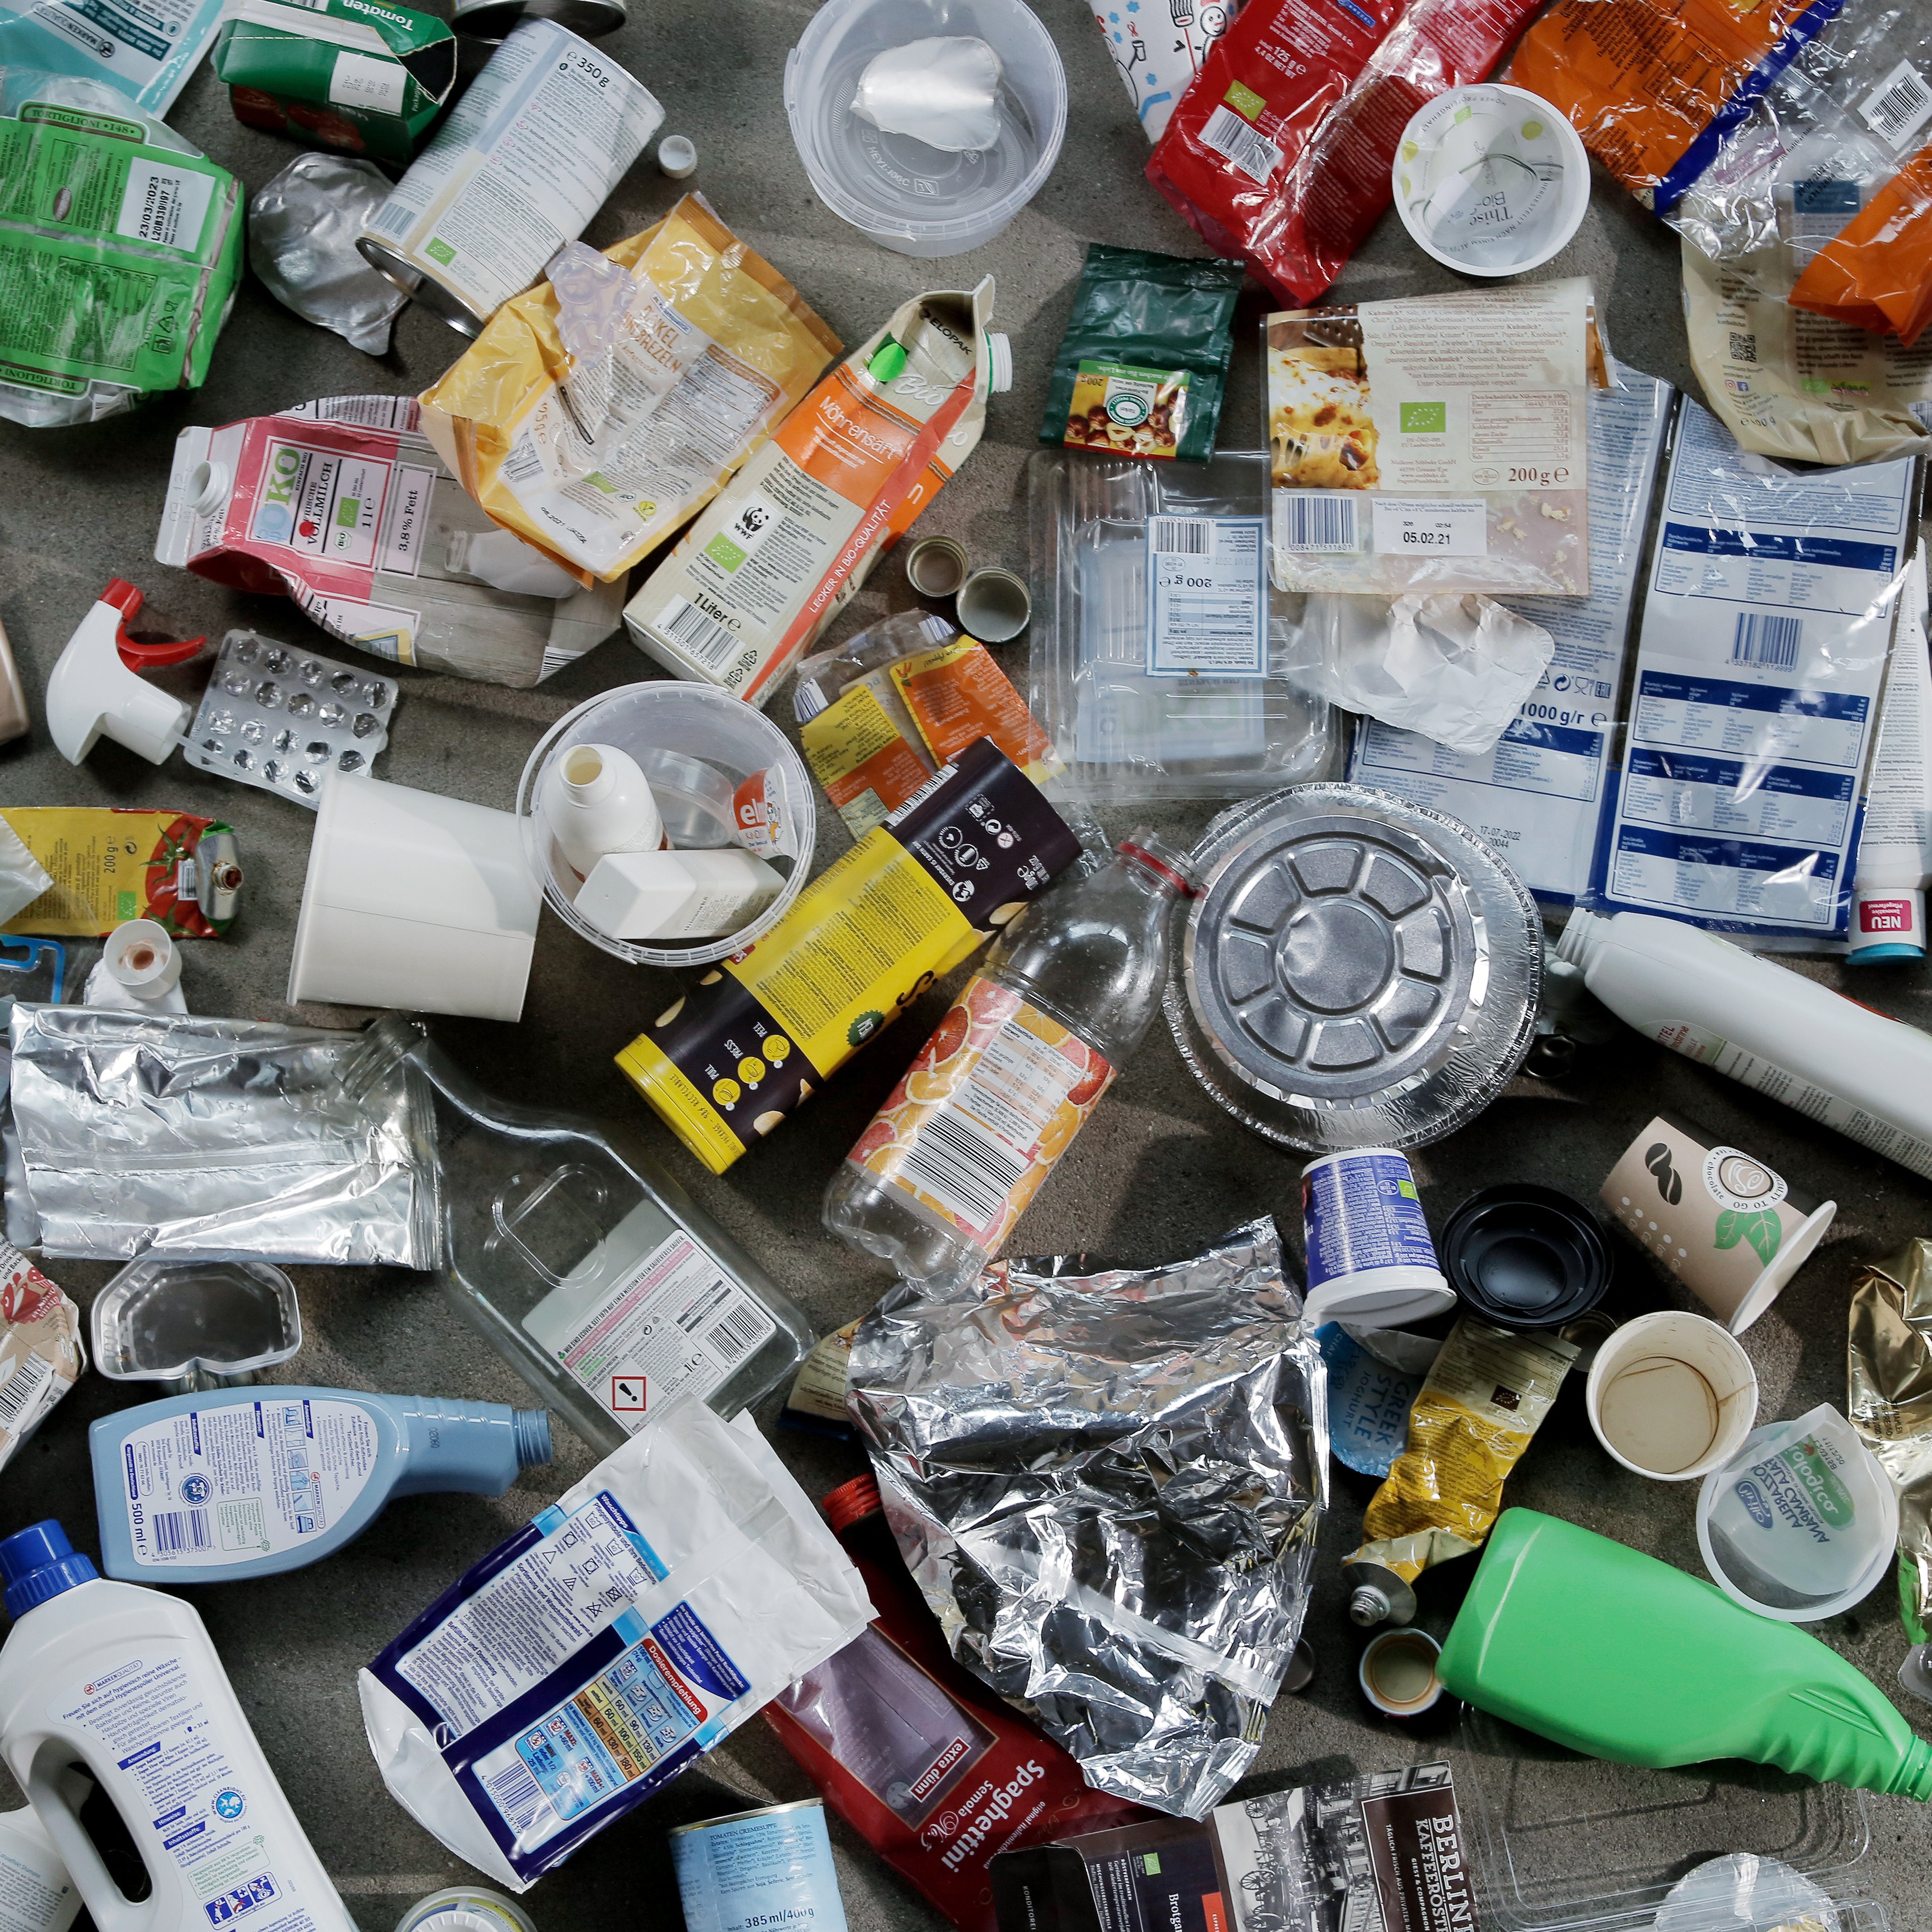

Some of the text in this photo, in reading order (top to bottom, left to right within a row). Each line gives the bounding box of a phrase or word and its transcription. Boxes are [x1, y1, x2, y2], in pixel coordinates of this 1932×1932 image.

[340, 0, 416, 31] Tomaten
[577, 56, 610, 88] 350 g
[1263, 52, 1274, 63] OZ
[1272, 59, 1286, 72] NET
[1271, 45, 1297, 69] 125 g
[32, 109, 100, 128] TORTIGLIONI
[138, 176, 159, 238] 23/03/2023
[1495, 224, 1515, 239] NACH
[929, 316, 972, 356] ELOPAK
[5, 368, 77, 390] TORTIGLIONI
[1508, 467, 1550, 486] 200 g
[404, 489, 418, 515] Fett
[731, 522, 755, 542] WWF
[1404, 531, 1450, 544] 05.02.21
[808, 497, 893, 614] LECKER IN BIO-QUALITÄT
[1174, 575, 1212, 587] 200 g
[694, 592, 729, 623] 1 Liter
[104, 855, 116, 872] 200
[919, 847, 933, 862] EARTH
[934, 863, 955, 887] EVERYDAY
[1871, 916, 1902, 928] NEU
[751, 1021, 768, 1038] PEEL
[723, 1038, 744, 1059] PRESS
[703, 1063, 720, 1081] PULL
[668, 1072, 701, 1107] RECYCLABLE
[711, 1122, 732, 1144] PACKAGE
[1733, 1201, 1747, 1209] GO
[1754, 1199, 1767, 1209] TO
[564, 1234, 685, 1353] WIR SIND ECOVER. SEIT 1979 AUF EINER MISSION FÜR EIN SAUBERERES SAUBER.
[731, 1343, 752, 1363] 412533
[750, 1324, 771, 1345] 420128
[1341, 1370, 1372, 1429] JOGHURT
[1353, 1372, 1392, 1440] STYLE
[1373, 1379, 1412, 1447] GREEK
[131, 1503, 146, 1542] 500 ml
[599, 1493, 629, 1530] Waschtipps
[592, 1501, 658, 1586] Pflegesymbole und ihre Bedeutung
[516, 1564, 583, 1637] Sortierung und Waschmittelwahl
[447, 1621, 498, 1675] Befüllung und Dosierung
[62, 1657, 177, 1720] Freuen Sie sich auf hygienisch reine Wäsche
[96, 1662, 139, 1687] MARKENQUALITÄT
[646, 1645, 701, 1716] Dosierempfehlung
[75, 1663, 180, 1721] mit dem domol Hygienespüler Universal.
[614, 1699, 657, 1760] 60 ml 90 ml 130 ml
[914, 1741, 965, 1796] extra dünn
[486, 1782, 505, 1808] 015000
[502, 1808, 522, 1835] 968119
[957, 1779, 995, 1818] Semola
[1022, 1801, 1047, 1824] original
[157, 1809, 182, 1826] Hinweise:
[939, 1757, 1048, 1874] Spaghettini
[167, 1825, 201, 1847] Inhaltsstoffe:
[710, 1822, 777, 1841] TOMATEN CREMESUPPE
[1120, 1859, 1132, 1900] RÖSTVERFAHREN
[1385, 1824, 1395, 1850] TÄGLICH
[1391, 1853, 1400, 1875] FRISCH
[1399, 1891, 1409, 1922] PRIVATER
[1411, 1858, 1419, 1877] GIEST
[745, 1906, 815, 1927] 385 ml/400 g
[1022, 1885, 1036, 1930] KONDITOREI
